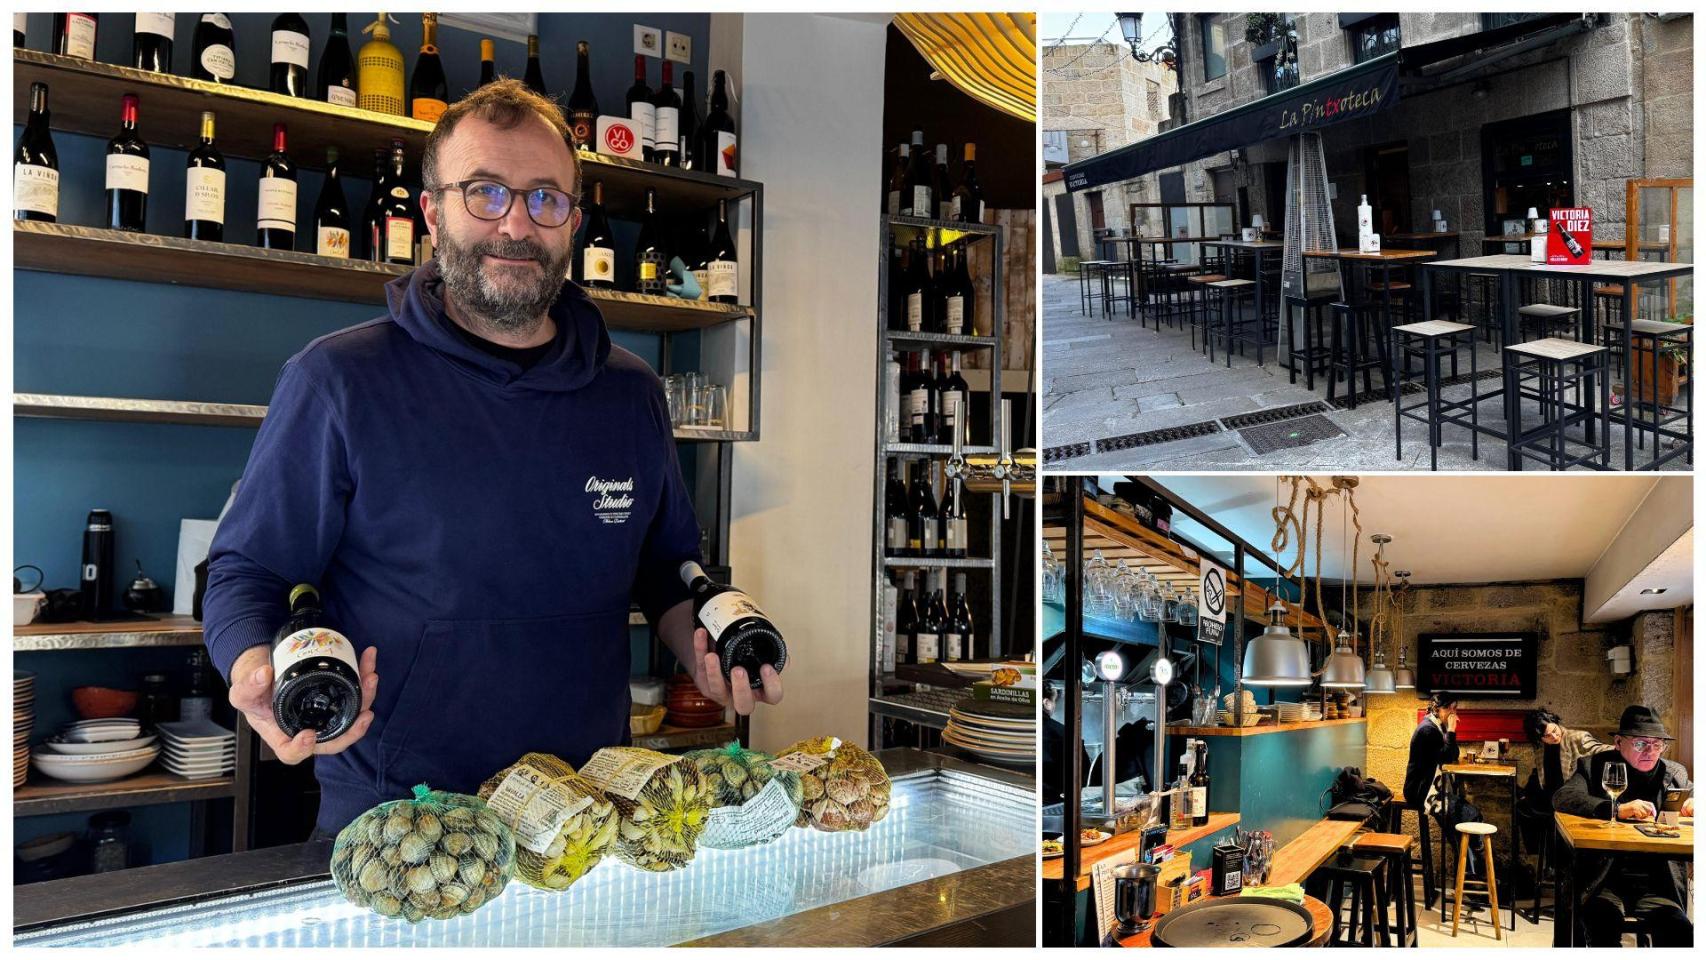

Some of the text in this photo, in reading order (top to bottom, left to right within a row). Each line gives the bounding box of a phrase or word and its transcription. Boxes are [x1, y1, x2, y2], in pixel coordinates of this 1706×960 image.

[1280, 87, 1382, 129] La Pintxoteca
[613, 128, 626, 139] VI
[610, 137, 629, 149] GO
[1551, 209, 1590, 220] VICTORIA
[1567, 220, 1590, 231] DIEZ
[585, 475, 634, 495] Originals
[593, 493, 634, 510] Studio
[1431, 647, 1522, 659] AQUÍ SOMOS DE
[1445, 661, 1507, 670] CERVEZAS
[1431, 673, 1521, 687] VICTORIA
[990, 687, 1030, 698] SARDINILLAS
